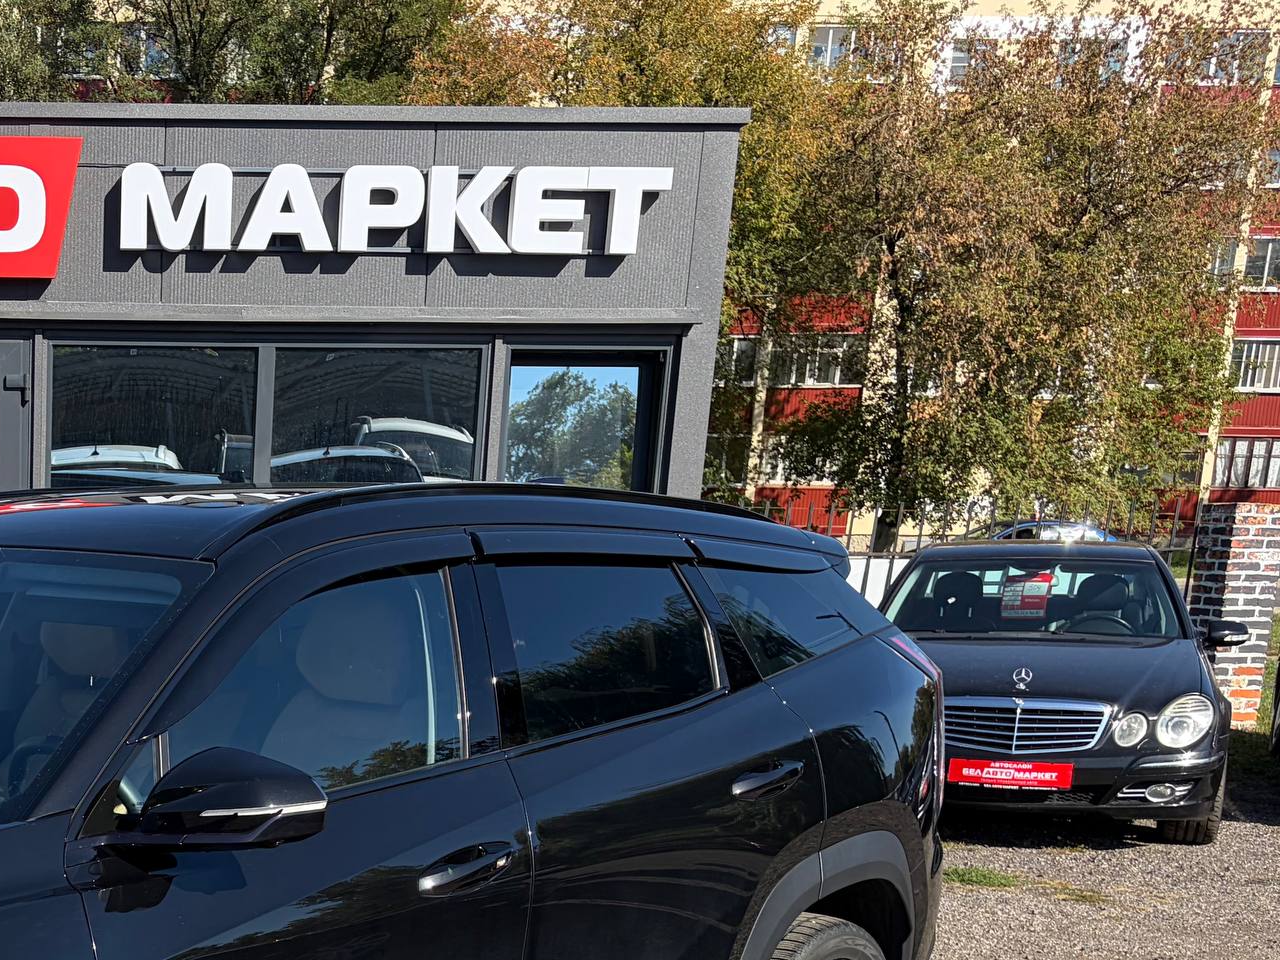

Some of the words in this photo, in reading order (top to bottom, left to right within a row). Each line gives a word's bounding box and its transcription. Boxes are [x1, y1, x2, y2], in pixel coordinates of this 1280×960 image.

[120, 161, 674, 257] МАРКЕТ
[962, 768, 981, 777] БЕЛ
[984, 769, 1011, 778] АВТО
[1014, 771, 1058, 780] МАРКЕТ
